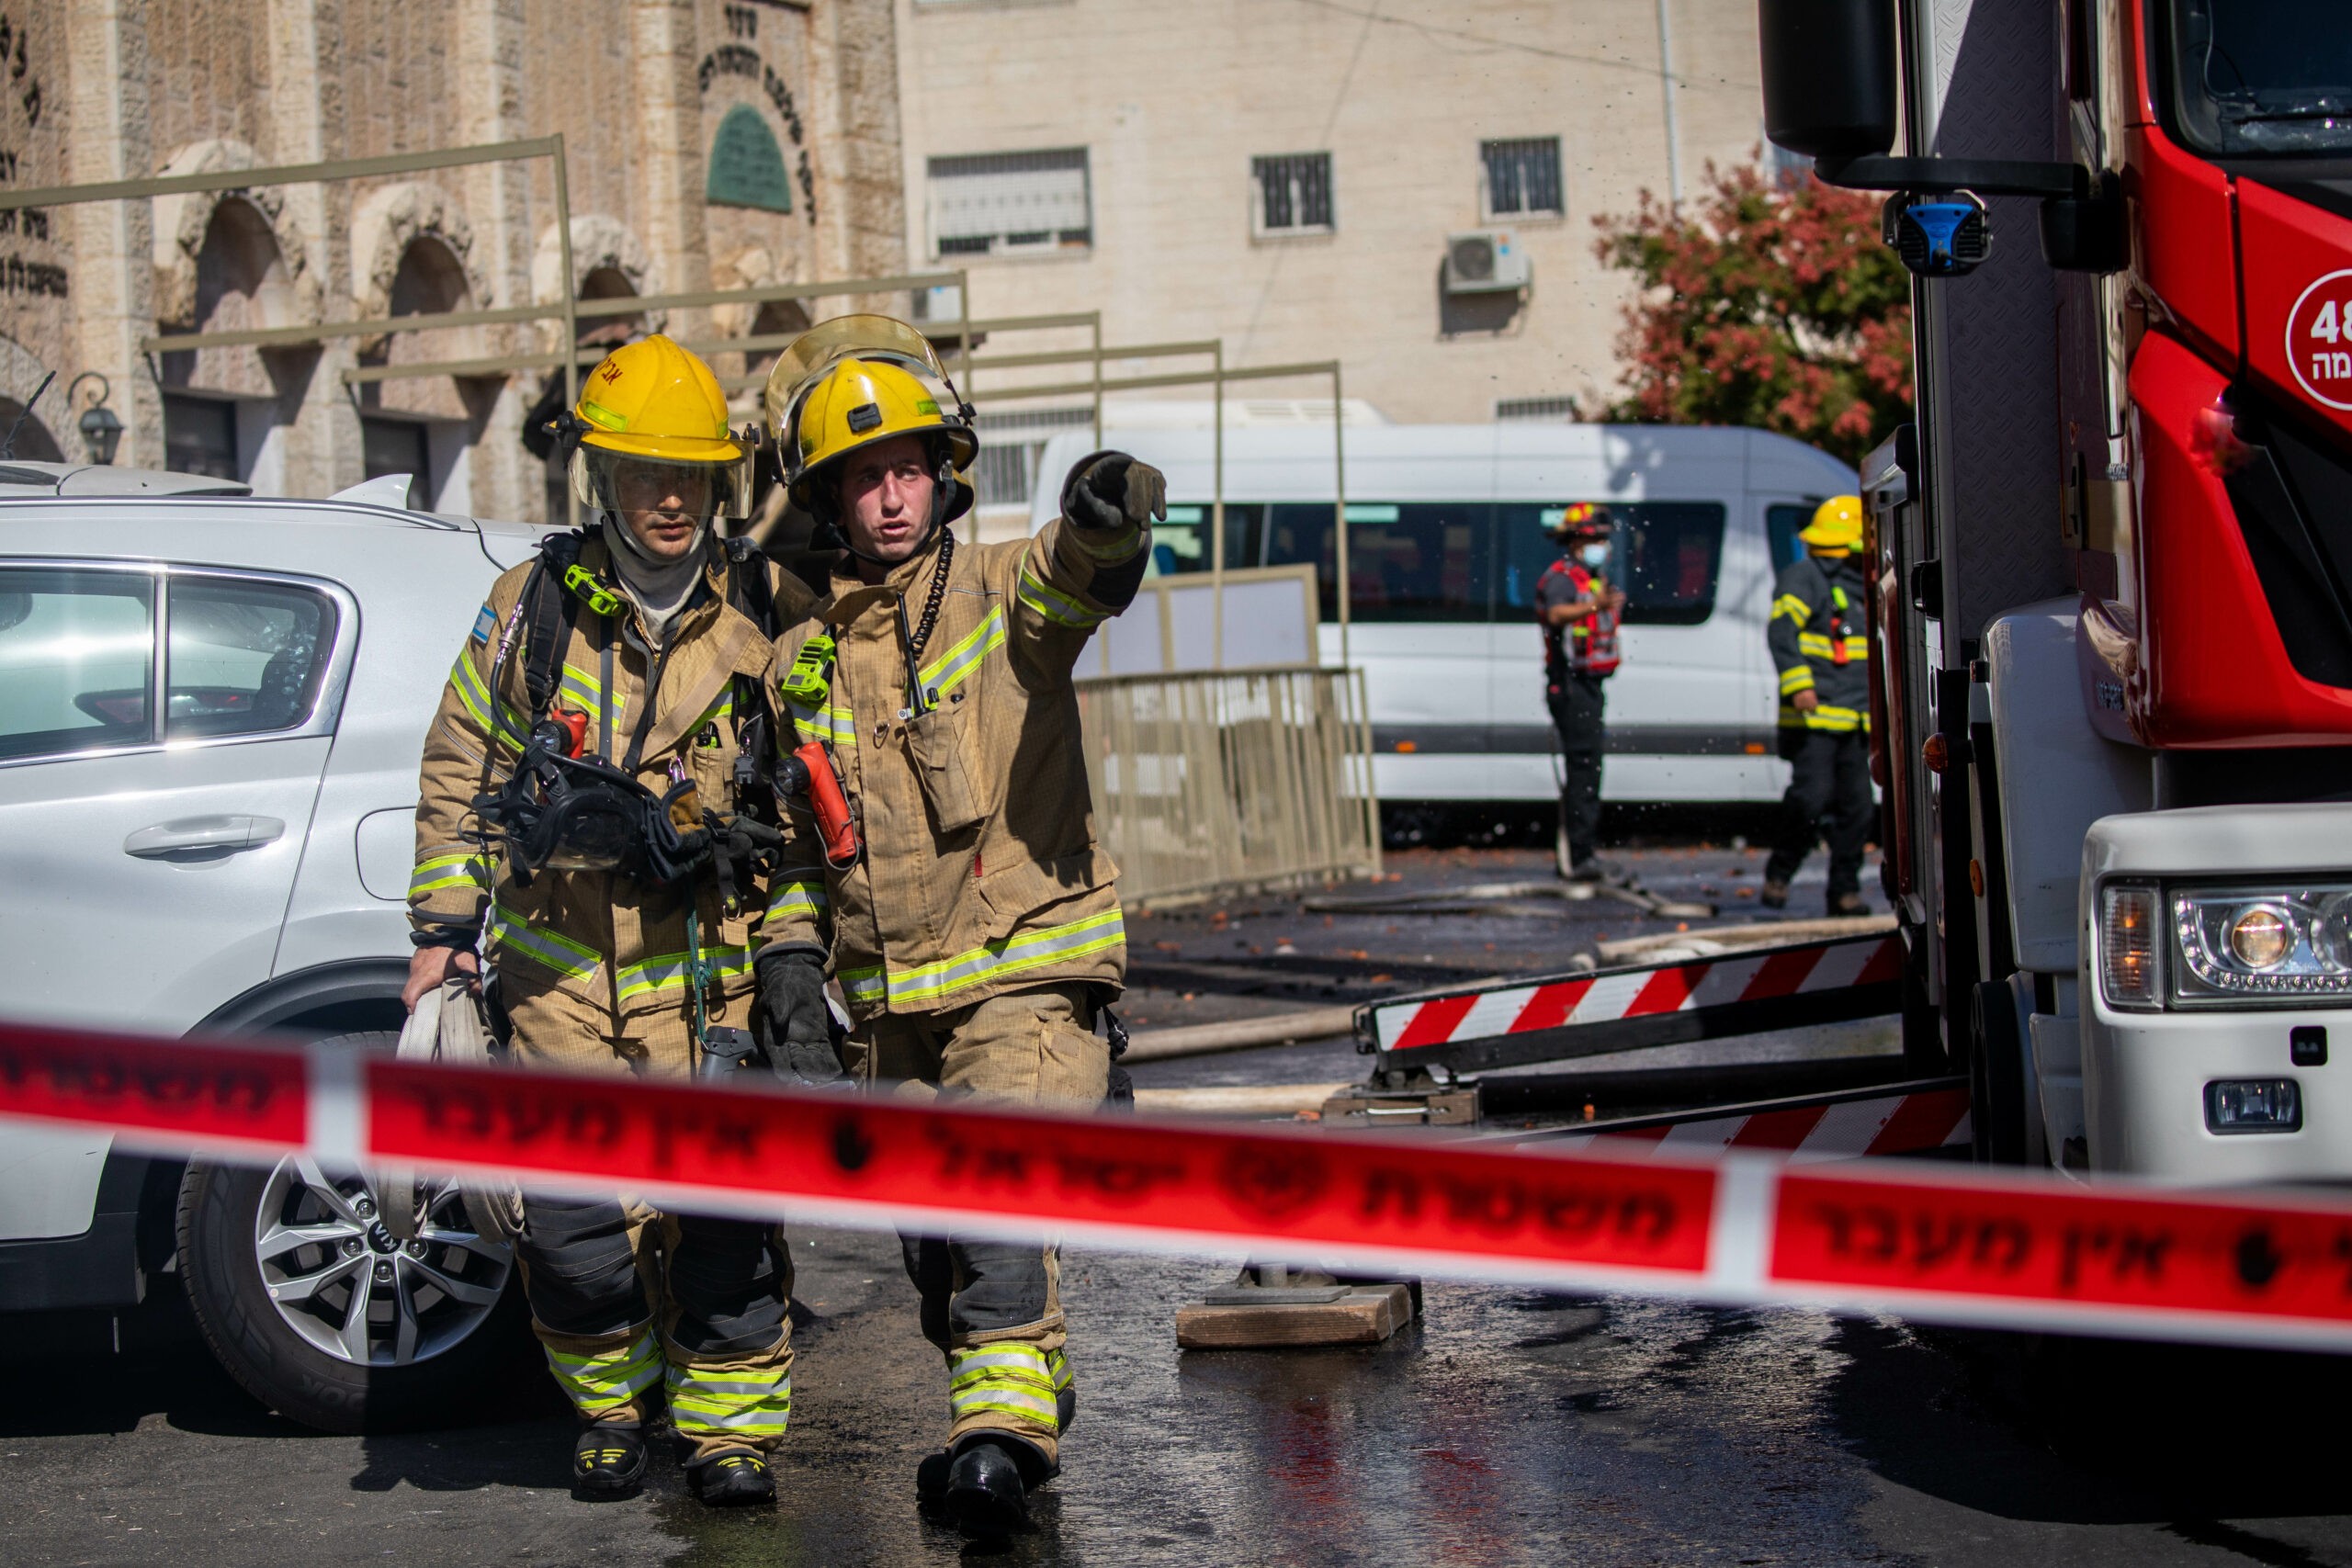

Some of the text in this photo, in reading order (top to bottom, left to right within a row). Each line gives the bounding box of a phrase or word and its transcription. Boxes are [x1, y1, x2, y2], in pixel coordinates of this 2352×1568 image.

[410, 1087, 1676, 1247] משטרת ישראל אין מעבר
[375, 1223, 397, 1251] KIA
[1814, 1201, 2172, 1293] אין מעבר
